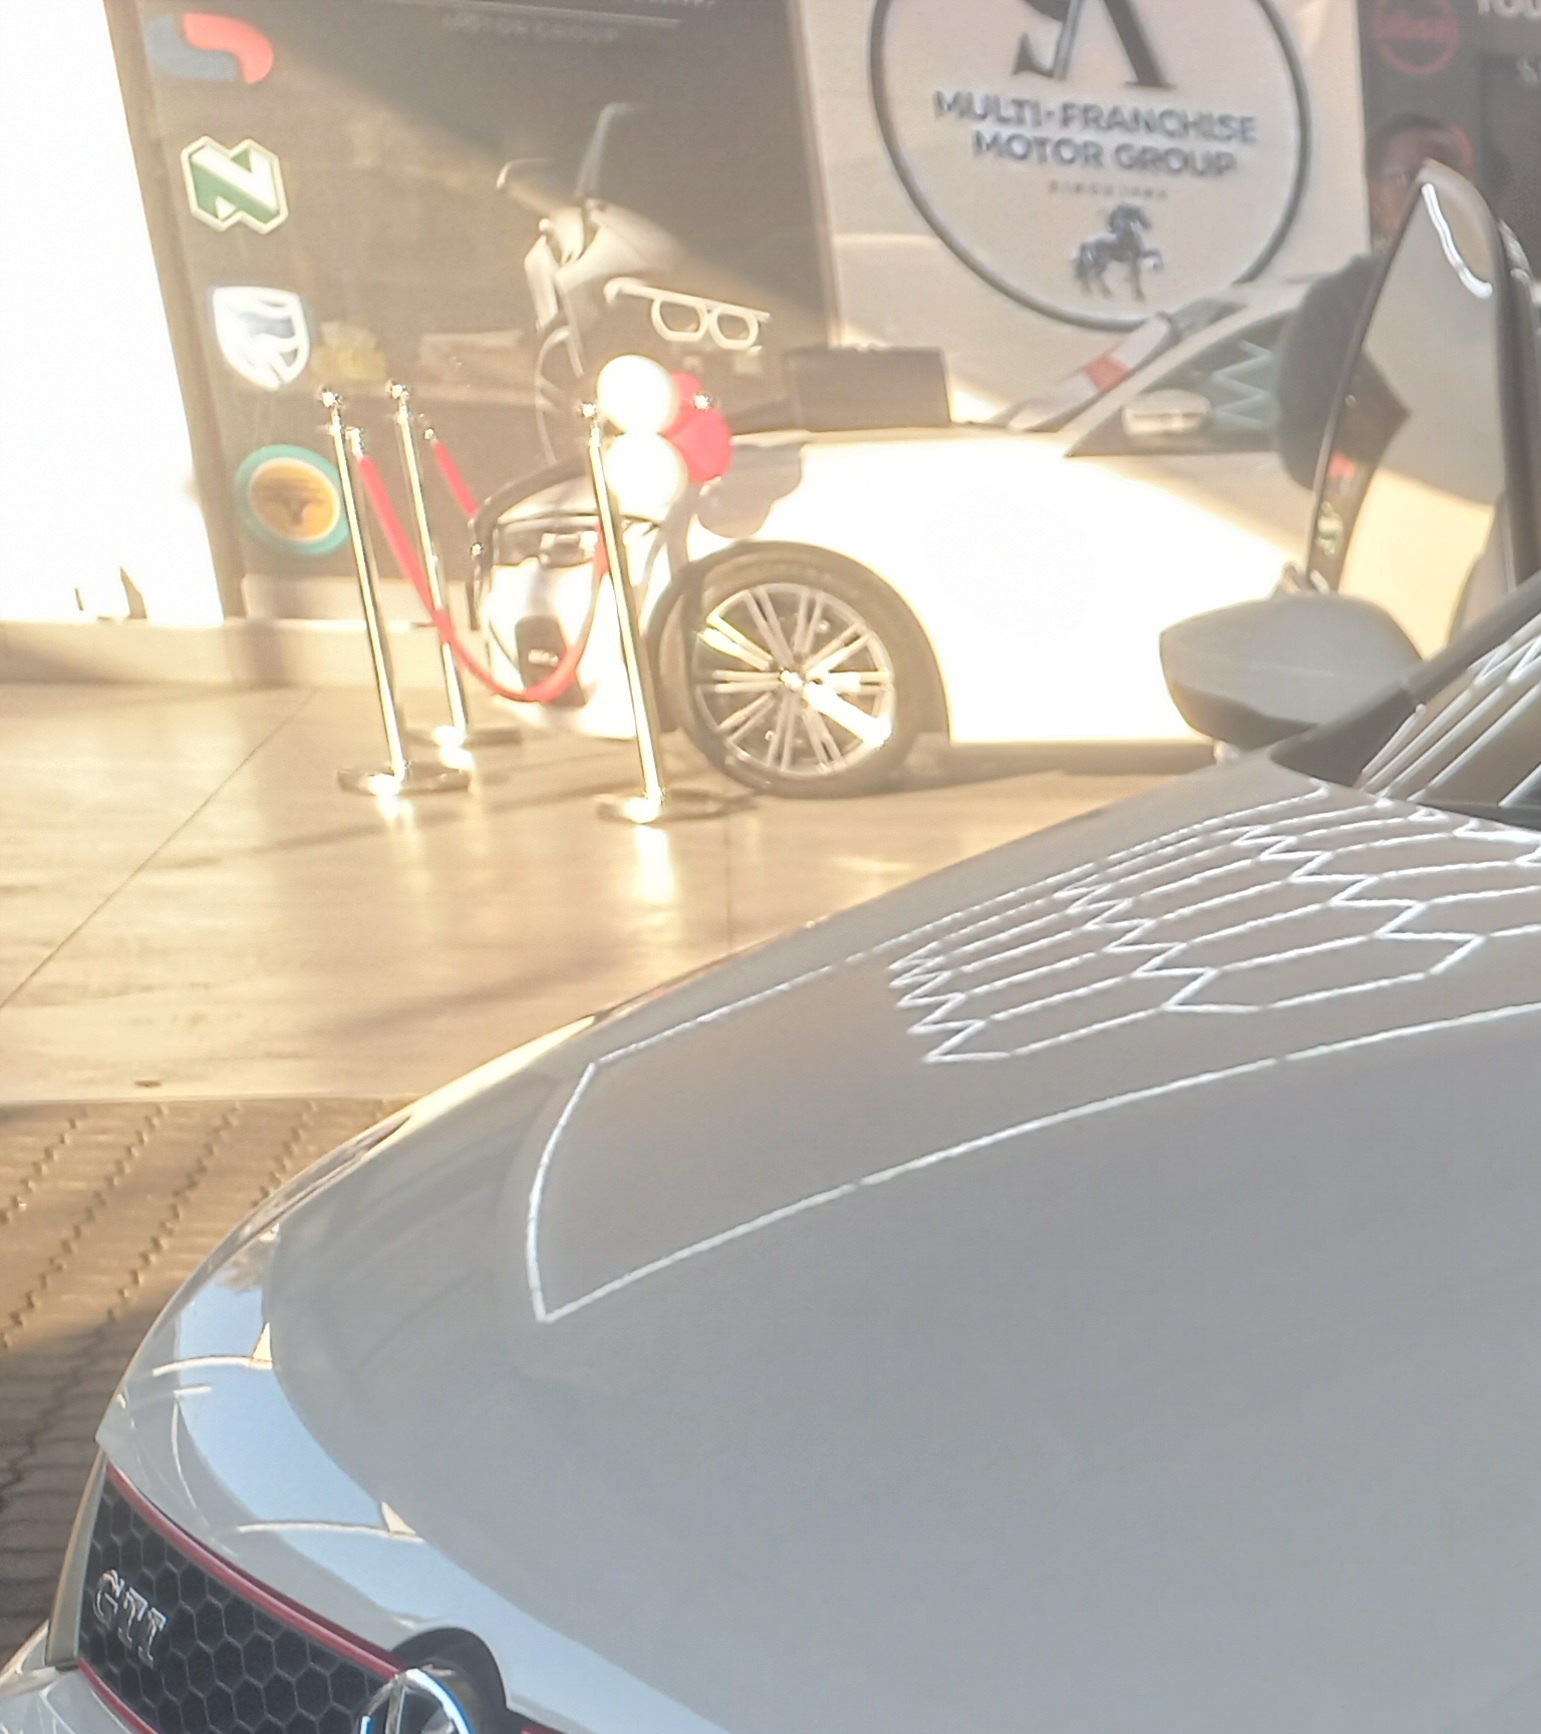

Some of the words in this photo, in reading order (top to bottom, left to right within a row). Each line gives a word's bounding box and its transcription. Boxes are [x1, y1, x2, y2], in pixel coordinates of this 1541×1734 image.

[934, 89, 1258, 143] MULTI-FRANCHISE
[972, 130, 1104, 169] MOTOR
[1114, 142, 1238, 177] GROUP
